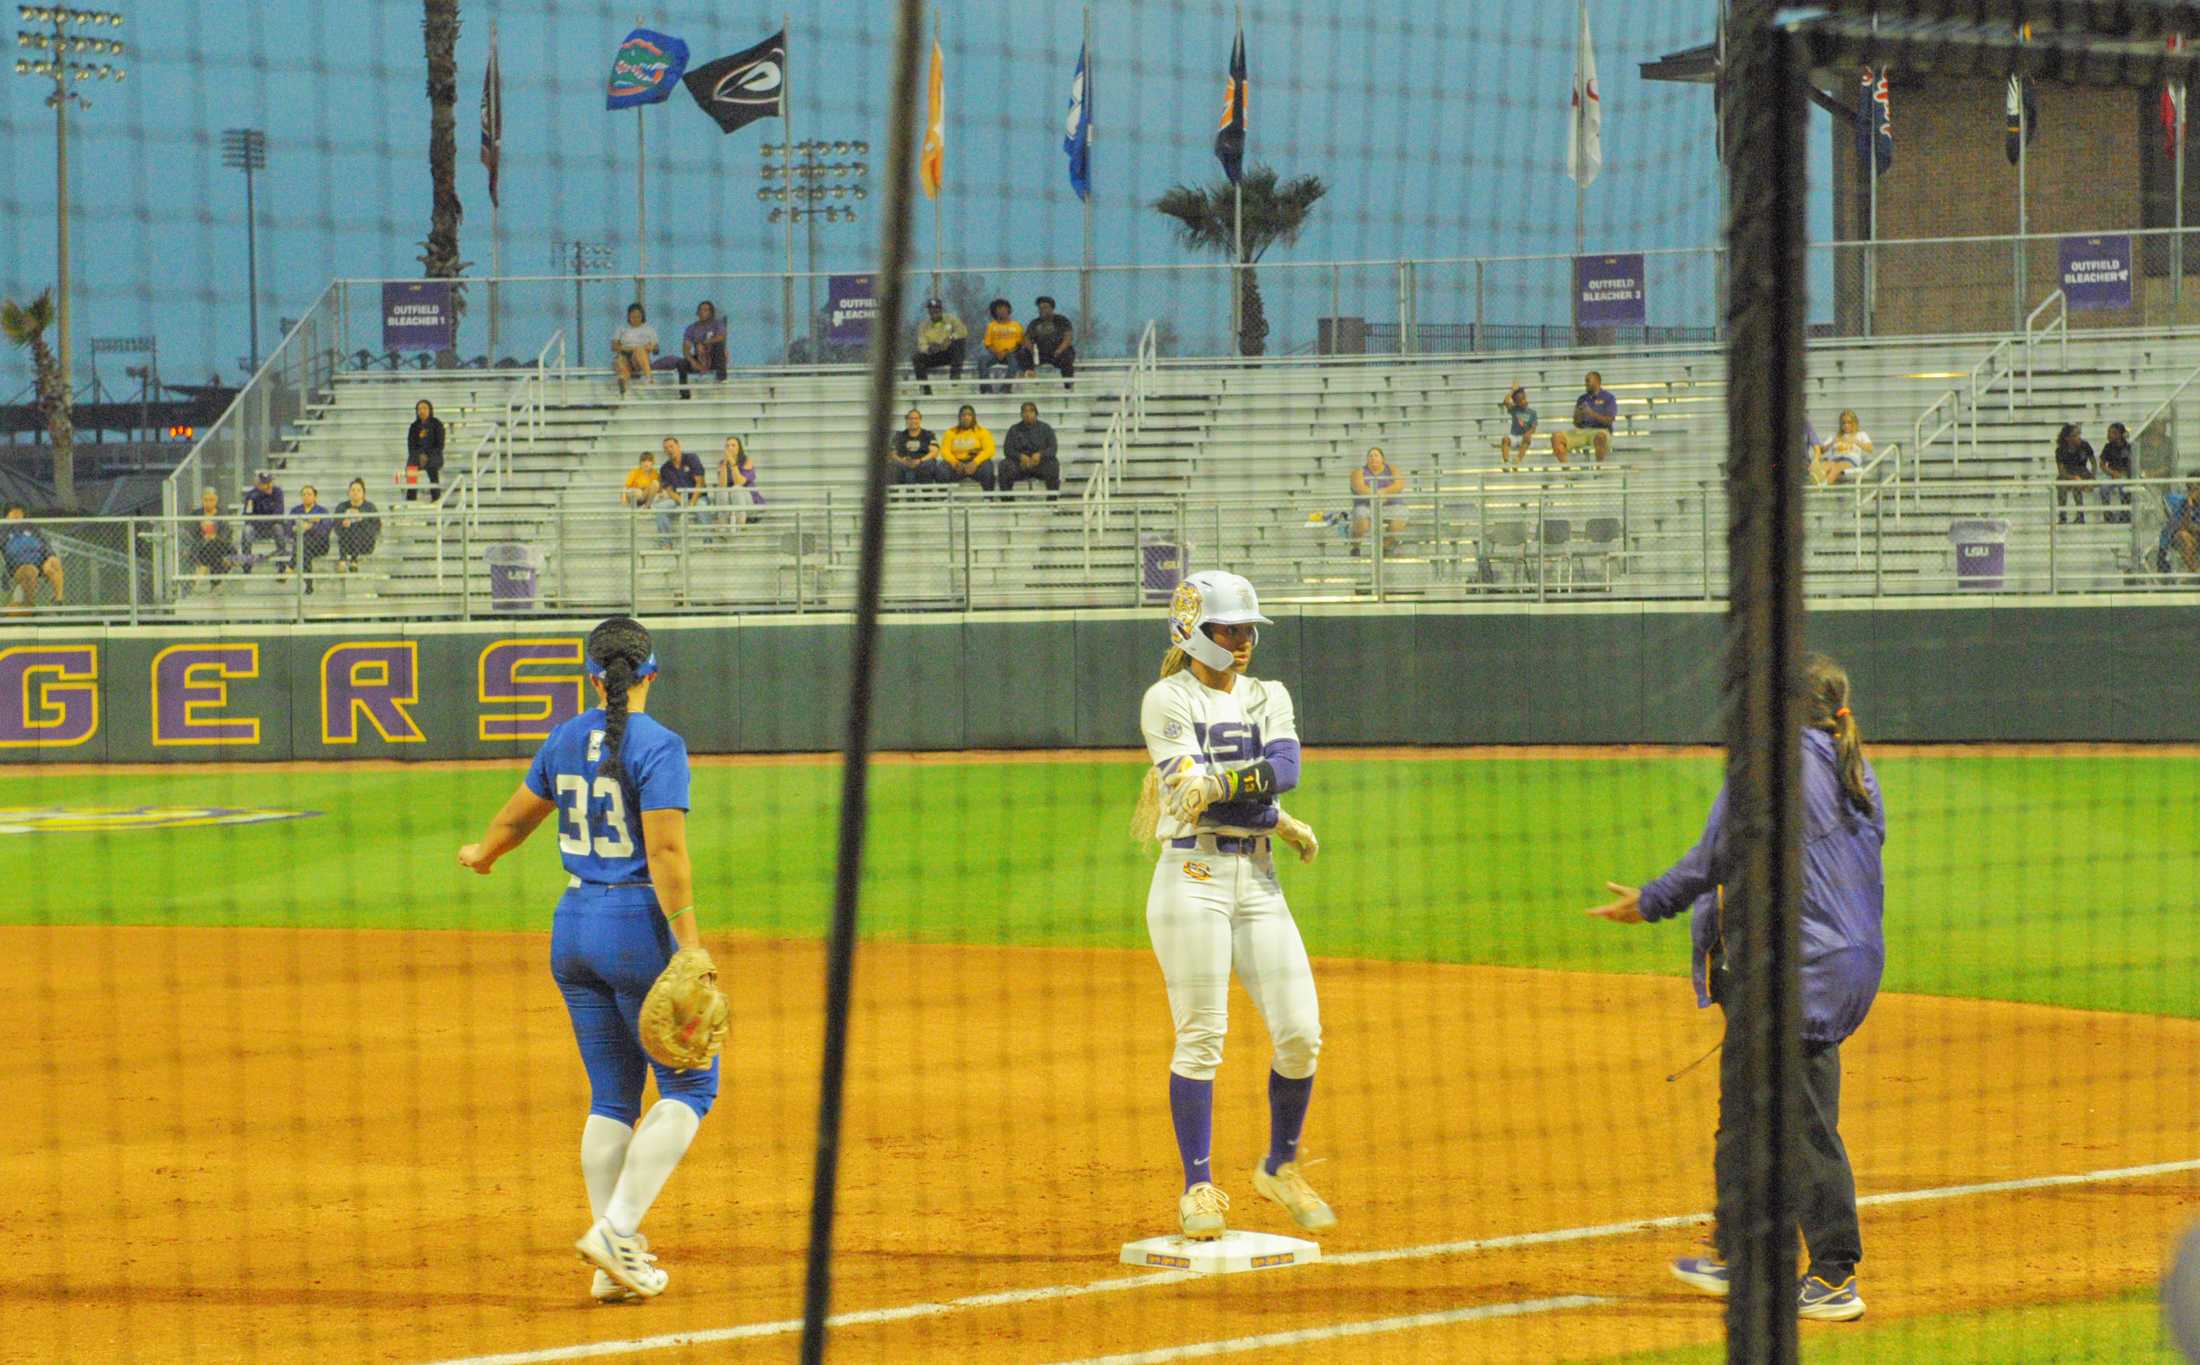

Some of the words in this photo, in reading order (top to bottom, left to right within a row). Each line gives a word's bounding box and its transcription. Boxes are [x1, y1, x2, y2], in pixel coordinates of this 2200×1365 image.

[2071, 260, 2119, 271] OUTFIELD
[2064, 271, 2118, 284] BLEACHER
[1588, 278, 1634, 289] OUTFIELD
[1583, 291, 1632, 301] BLEACHER
[393, 304, 439, 315] OUTFIELD
[387, 316, 438, 326] BLEACHER
[439, 316, 445, 325] 1
[1964, 545, 1990, 558] LSU
[556, 774, 634, 857] 33
